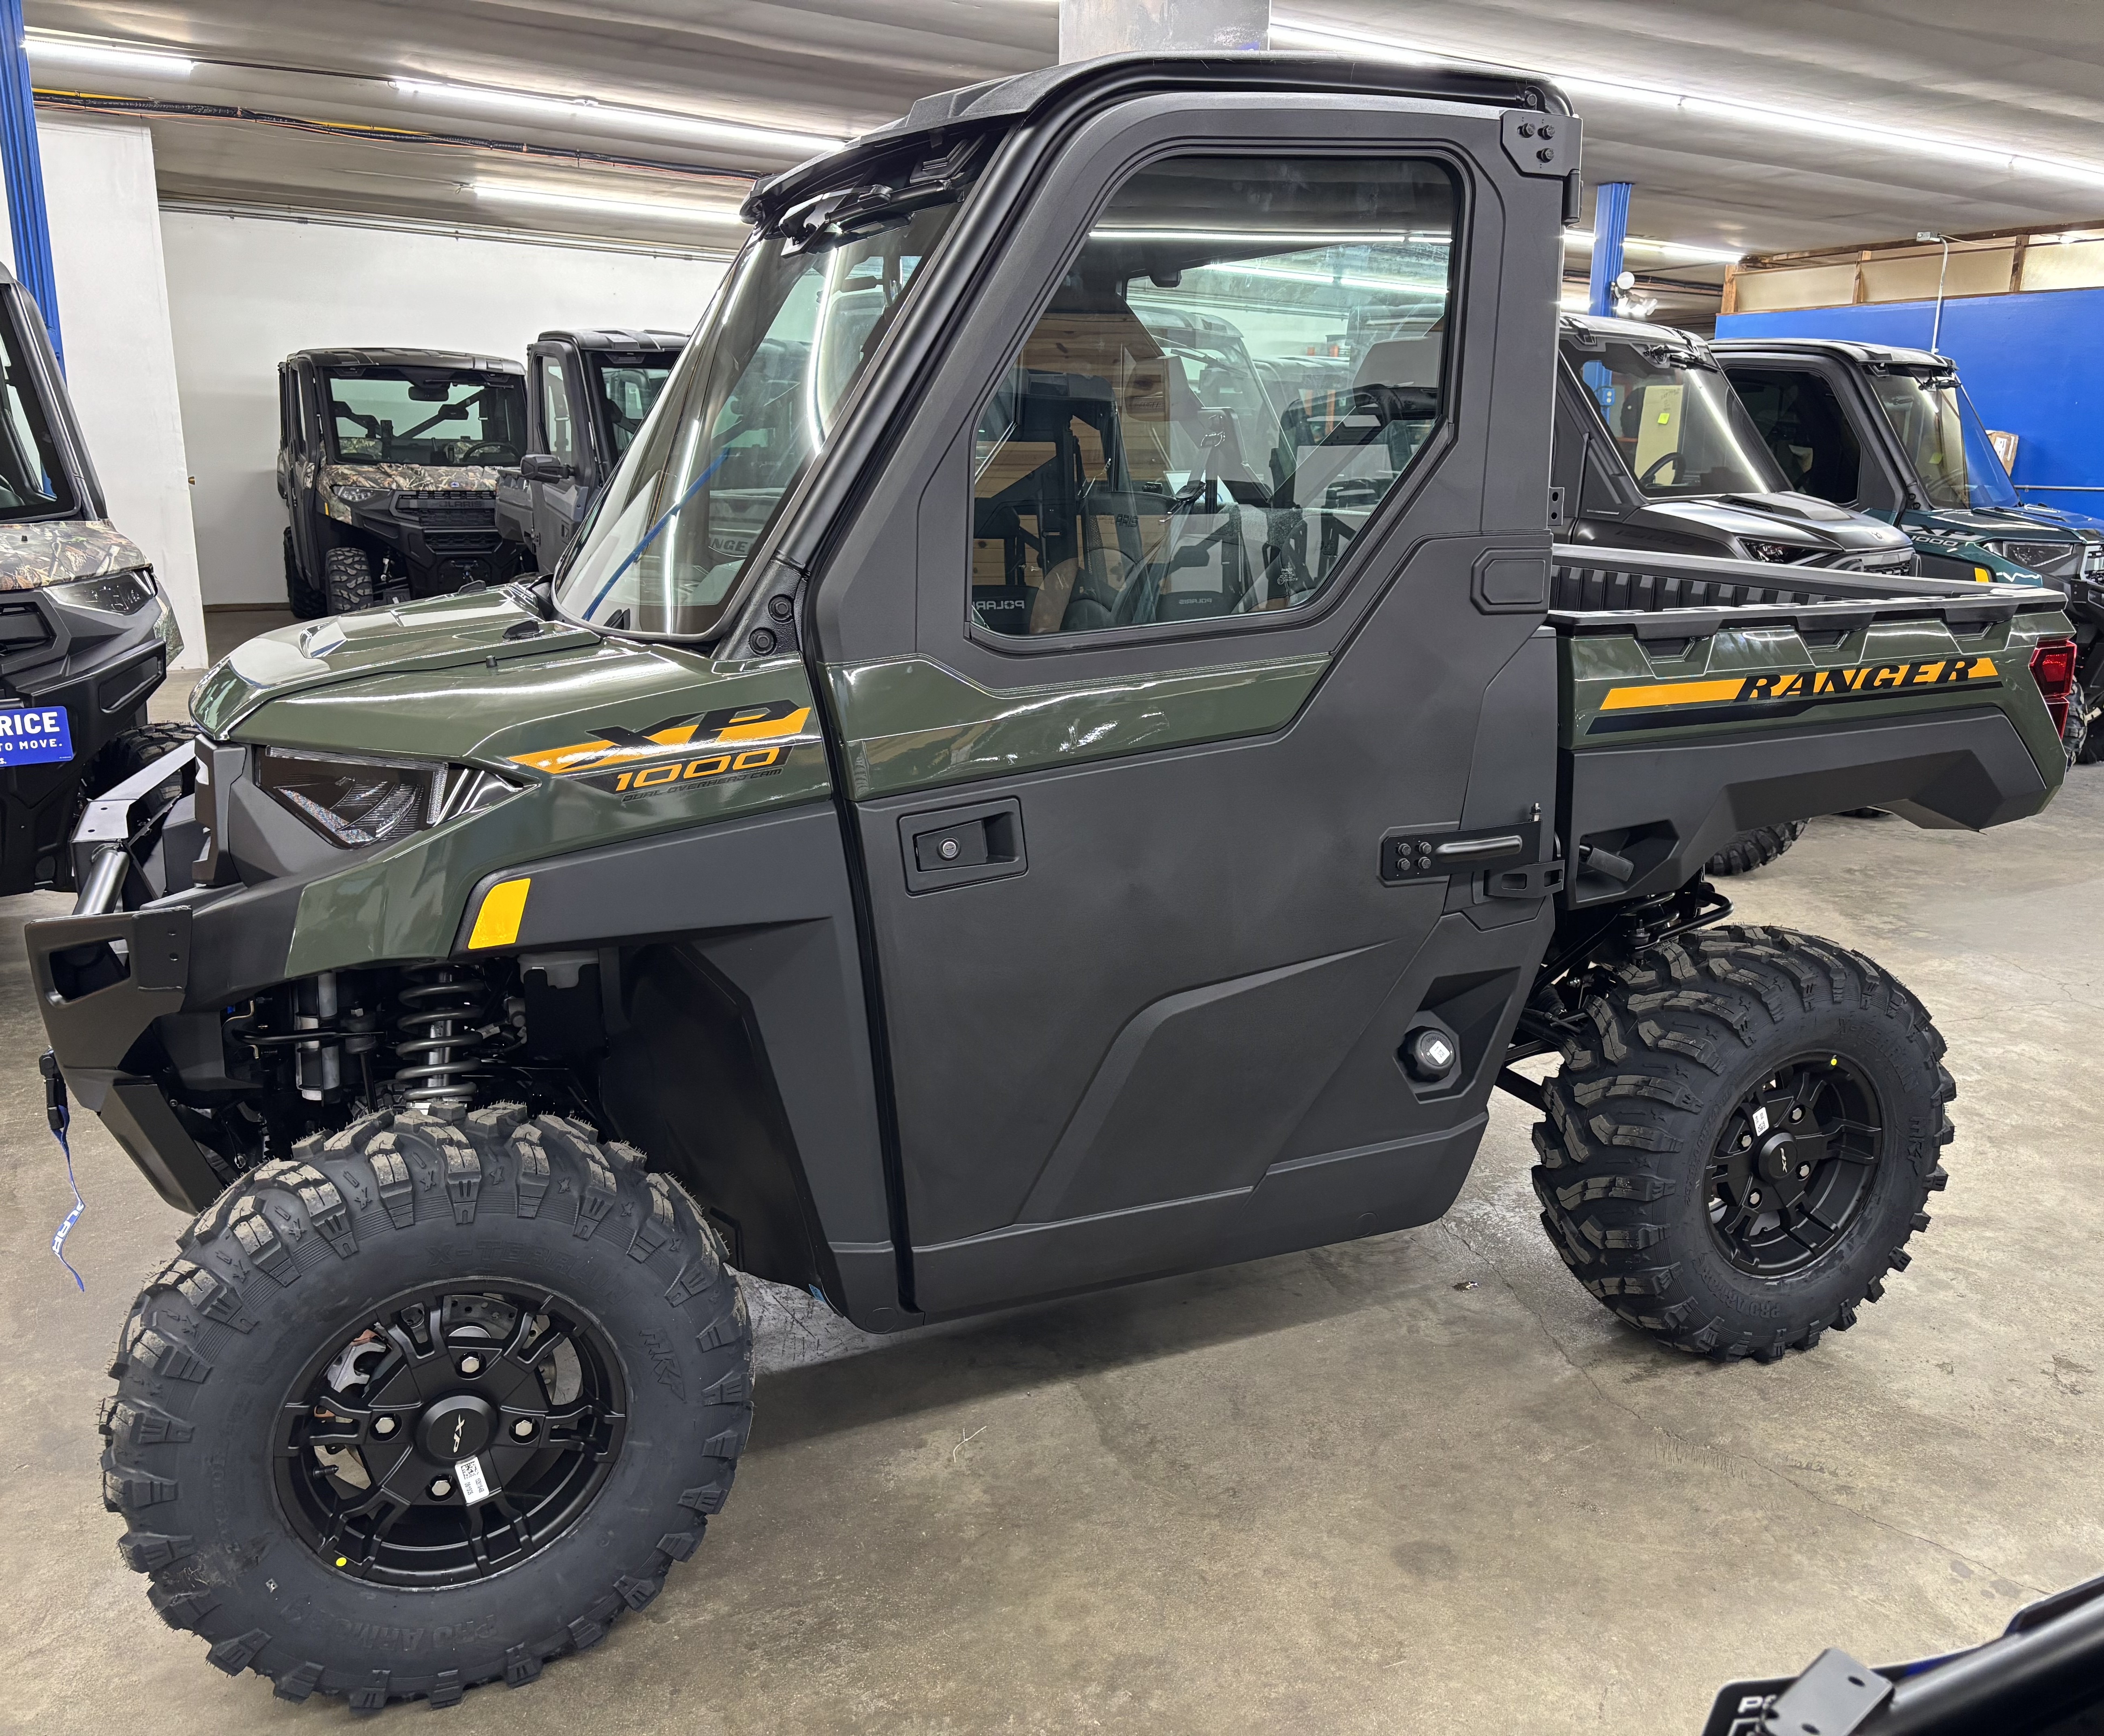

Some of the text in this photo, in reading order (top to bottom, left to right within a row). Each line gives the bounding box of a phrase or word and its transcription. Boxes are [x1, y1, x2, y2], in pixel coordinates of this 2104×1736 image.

[1907, 524, 1979, 539] XP
[1911, 535, 1958, 546] 1000
[1733, 657, 1979, 703] RANGER
[19, 739, 62, 750] MOVE.
[558, 699, 804, 770] XP
[615, 748, 780, 791] 1000
[623, 768, 782, 802] DUAL OVERHEAD CAM
[1749, 1300, 1781, 1319] PRO
[453, 1414, 465, 1453] XP
